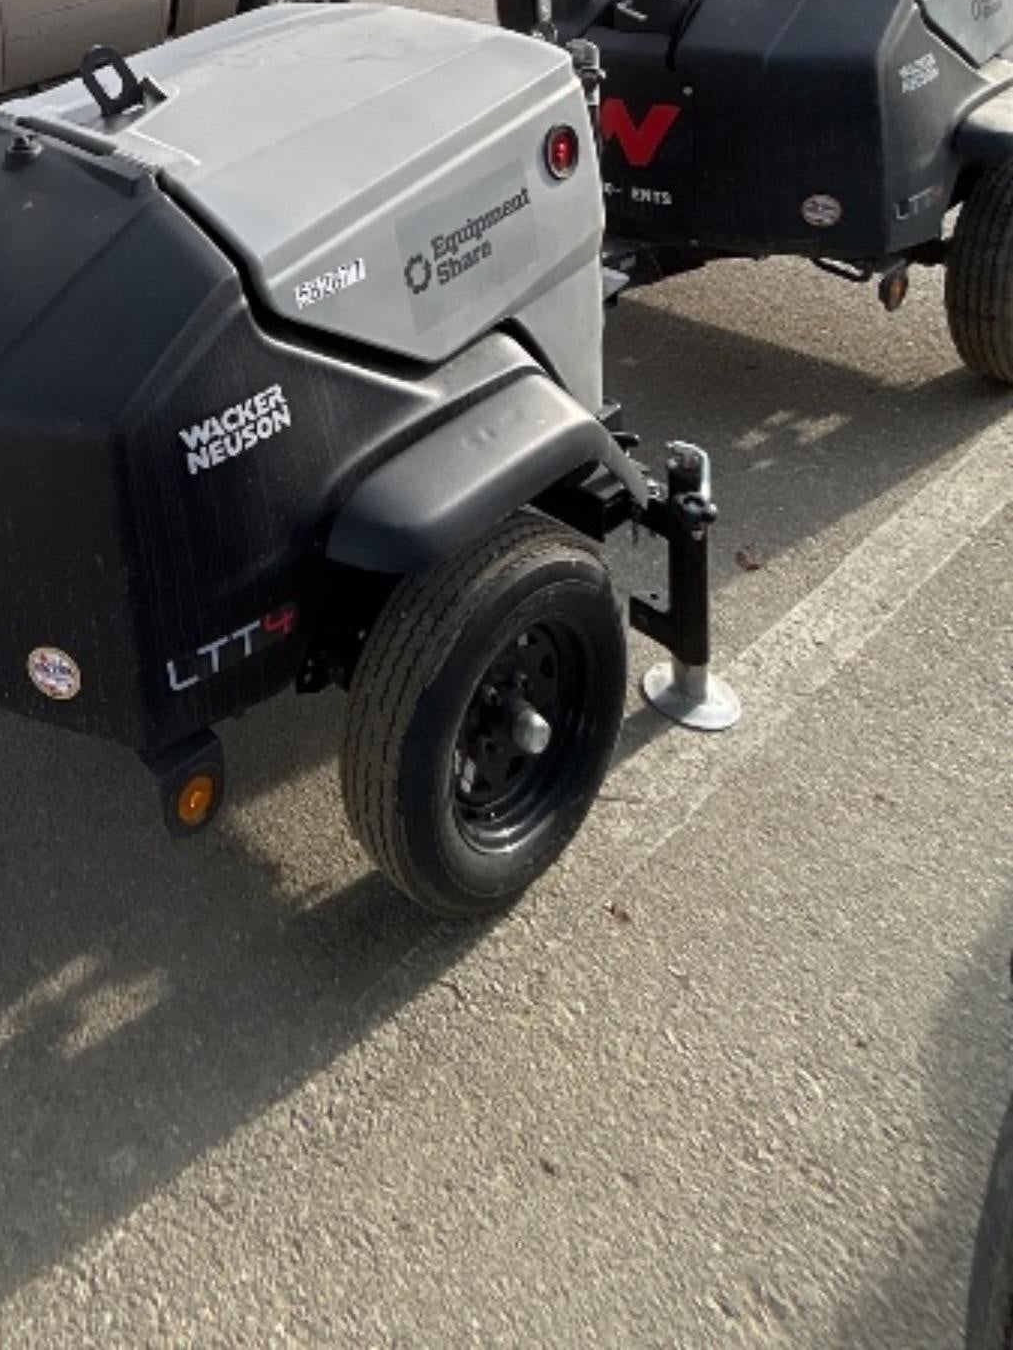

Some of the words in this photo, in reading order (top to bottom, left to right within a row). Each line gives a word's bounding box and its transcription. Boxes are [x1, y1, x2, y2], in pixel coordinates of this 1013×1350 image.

[430, 187, 532, 261] Equipment
[435, 240, 493, 286] Share
[178, 383, 288, 451] WACKER
[187, 403, 292, 476] NEUSON
